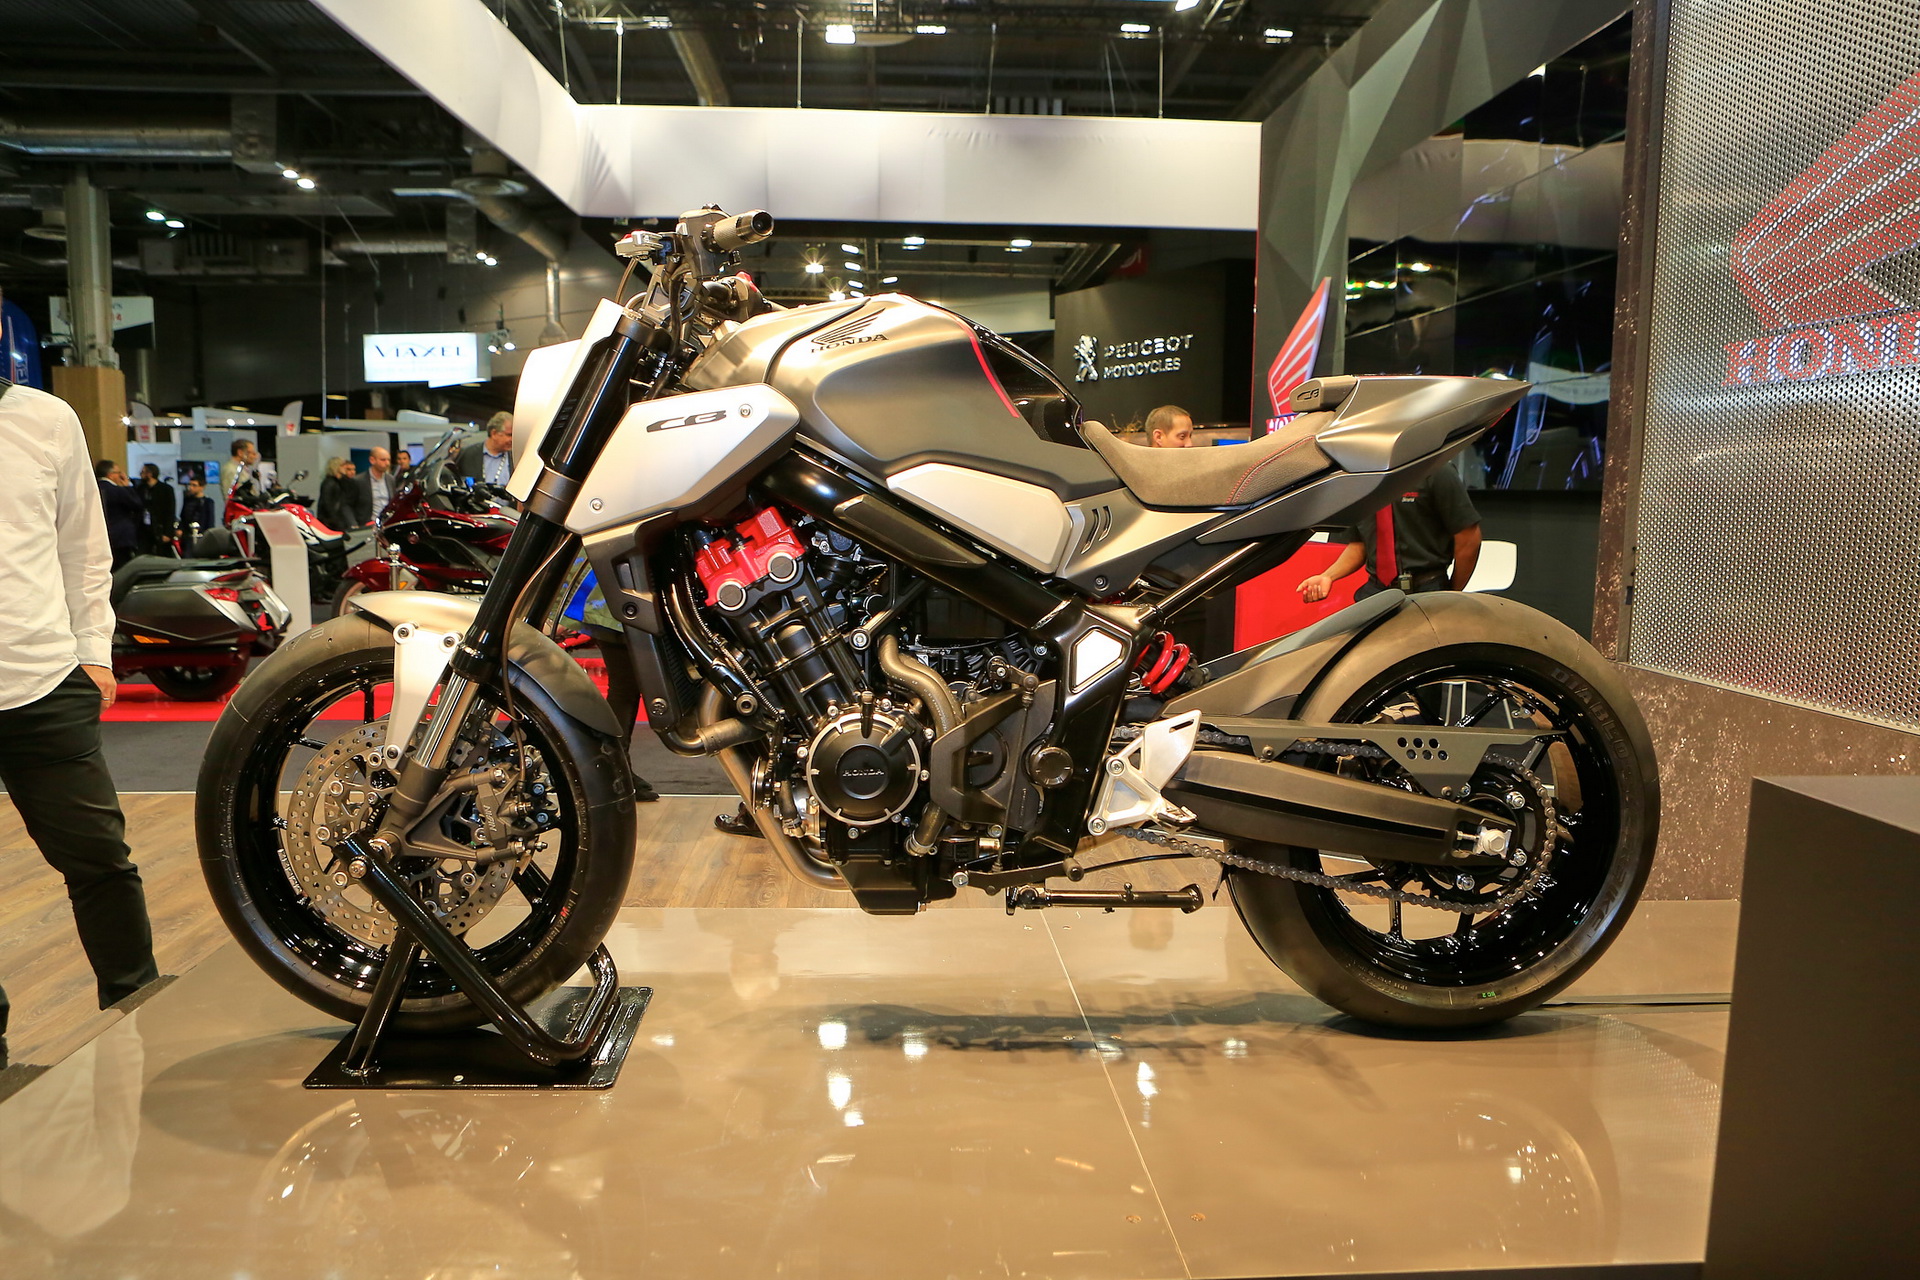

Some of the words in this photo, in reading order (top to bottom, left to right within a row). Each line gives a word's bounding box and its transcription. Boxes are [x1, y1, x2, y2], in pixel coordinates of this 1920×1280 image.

[375, 345, 467, 358] VIAXEL
[811, 334, 889, 353] HONDA
[1103, 334, 1194, 359] PEUGEOT
[1723, 309, 1920, 386] HON
[1103, 357, 1181, 379] MOTOCYCLES
[1296, 388, 1320, 401] CB
[646, 410, 727, 433] CB
[842, 768, 885, 777] HONDA
